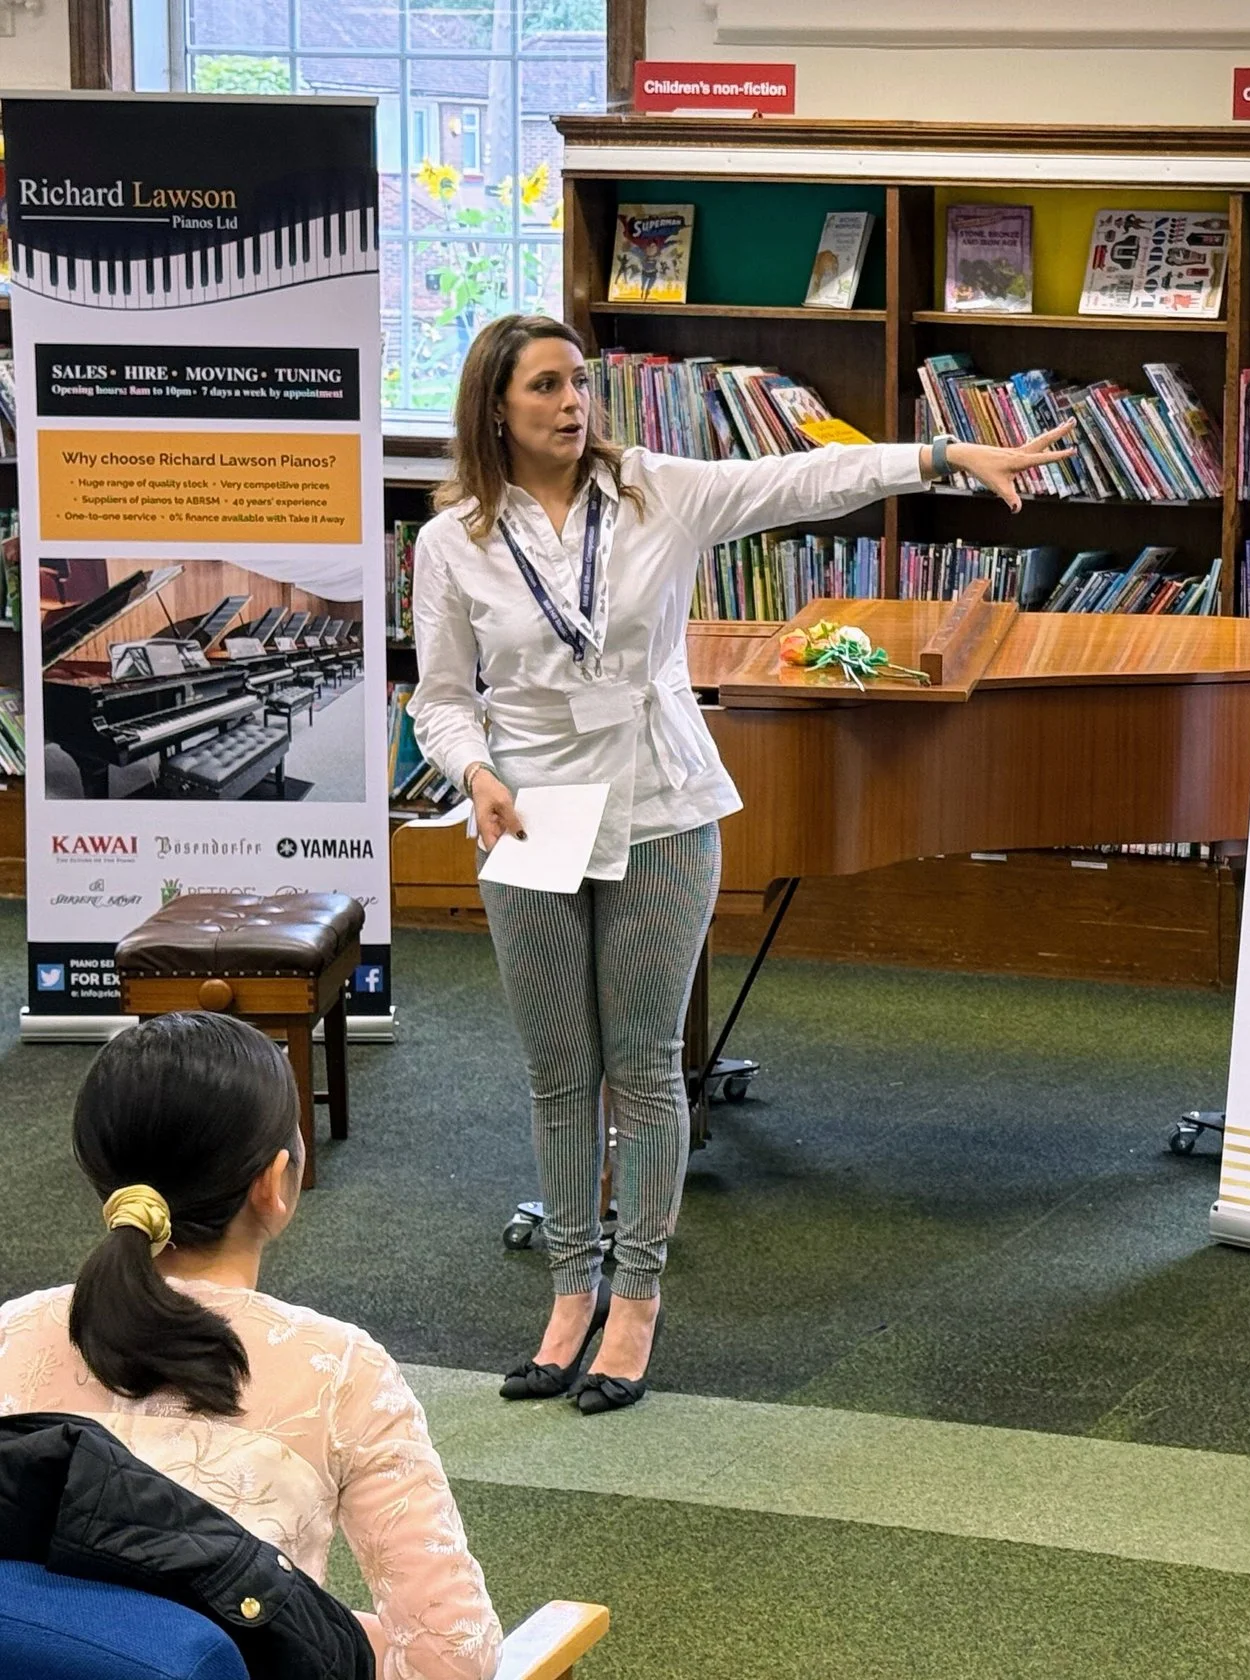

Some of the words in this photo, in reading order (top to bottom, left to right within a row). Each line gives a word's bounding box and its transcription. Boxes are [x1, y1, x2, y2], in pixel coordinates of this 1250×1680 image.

[644, 80, 711, 95] Children's
[713, 82, 787, 96] non-fiction
[19, 178, 125, 207] Richard
[132, 181, 238, 209] Lawson
[172, 215, 214, 229] Pianos
[217, 216, 238, 230] Ltd
[632, 218, 682, 238] SUPERMAN
[52, 364, 108, 380] SALES
[124, 365, 169, 381] HIRE
[185, 366, 259, 382] MOVING
[274, 367, 343, 383] TUNING
[51, 384, 95, 397] Opening
[152, 386, 163, 396] to
[201, 386, 208, 396] 7
[210, 386, 233, 399] days
[234, 389, 241, 397] a
[242, 387, 267, 398] week
[269, 387, 281, 400] by
[283, 388, 344, 400] appointment
[62, 451, 97, 468] Why
[101, 452, 155, 465] choose
[160, 453, 216, 466] Richard
[220, 454, 277, 467] Lawson
[280, 454, 336, 468] Pianos?
[78, 479, 105, 489] Huge
[107, 480, 135, 489] range
[137, 479, 147, 488] of
[148, 479, 181, 490] quality
[183, 479, 209, 489] stock
[220, 480, 242, 491] Very
[243, 480, 300, 491] competitive
[301, 481, 330, 491] prices
[81, 495, 127, 505] Suppliers
[129, 495, 139, 505] of
[141, 496, 172, 506] pianos
[174, 496, 184, 505] to
[232, 498, 245, 507] 40
[276, 498, 328, 508] experience
[64, 511, 121, 521] One-to-one
[123, 512, 157, 521] service
[185, 513, 220, 522] finance
[221, 513, 265, 523] available
[266, 514, 287, 523] with
[289, 514, 310, 523] Take
[320, 515, 345, 526] Away
[52, 835, 138, 854] KAWAI
[300, 838, 375, 859] YAMAHA
[70, 959, 99, 968] PIANO
[71, 972, 100, 986] FOR
[102, 972, 121, 986] EX
